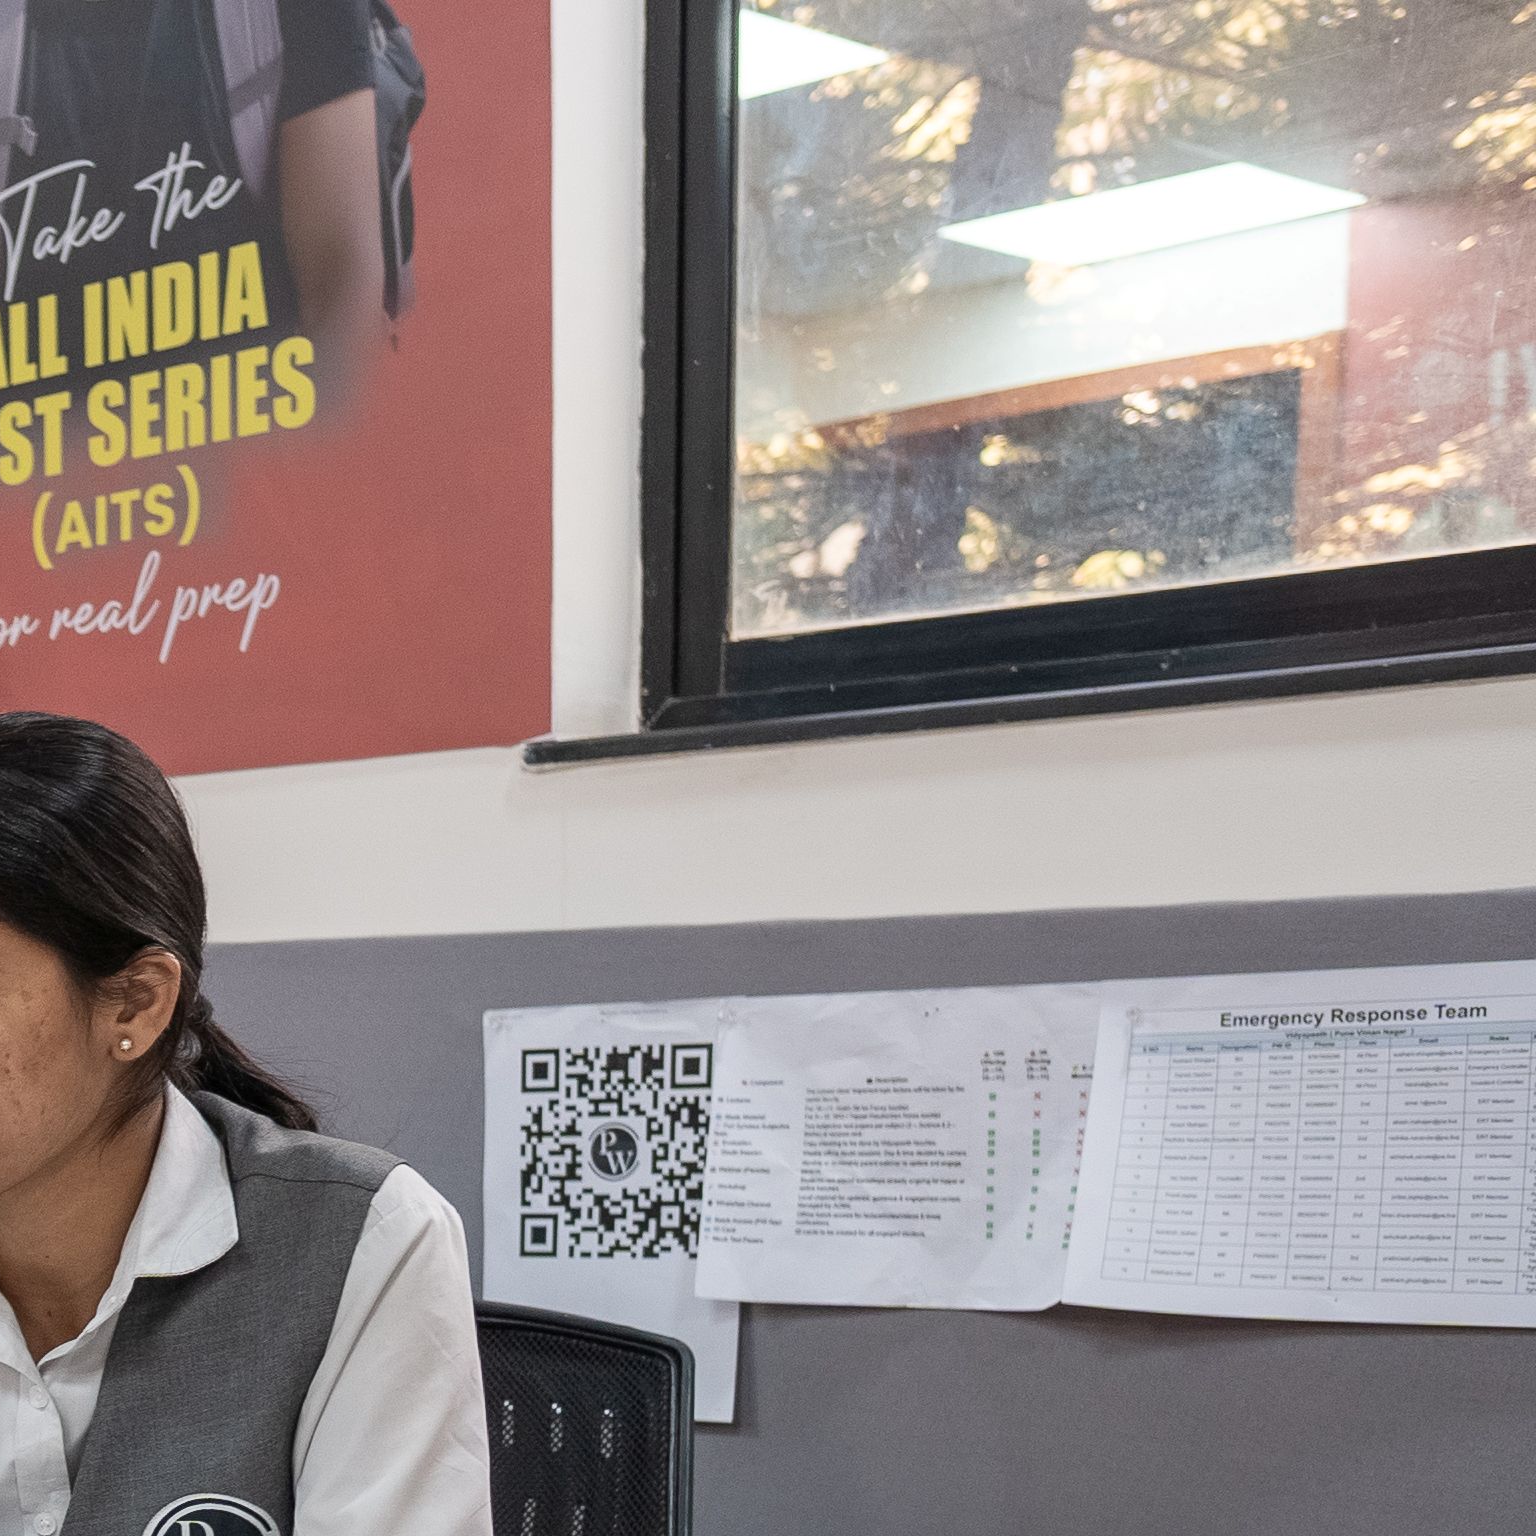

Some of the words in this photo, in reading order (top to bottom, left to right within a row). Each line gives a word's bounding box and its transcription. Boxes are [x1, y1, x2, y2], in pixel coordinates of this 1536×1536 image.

[135, 141, 242, 249] the
[83, 241, 269, 368] INDIA
[86, 336, 317, 468] SERIES
[31, 464, 202, 570] (AITS)
[49, 550, 162, 642] real
[159, 572, 281, 663] prep
[1220, 1010, 1324, 1031] Emergency
[1331, 1005, 1428, 1027] Response
[1434, 1001, 1488, 1020] Team
